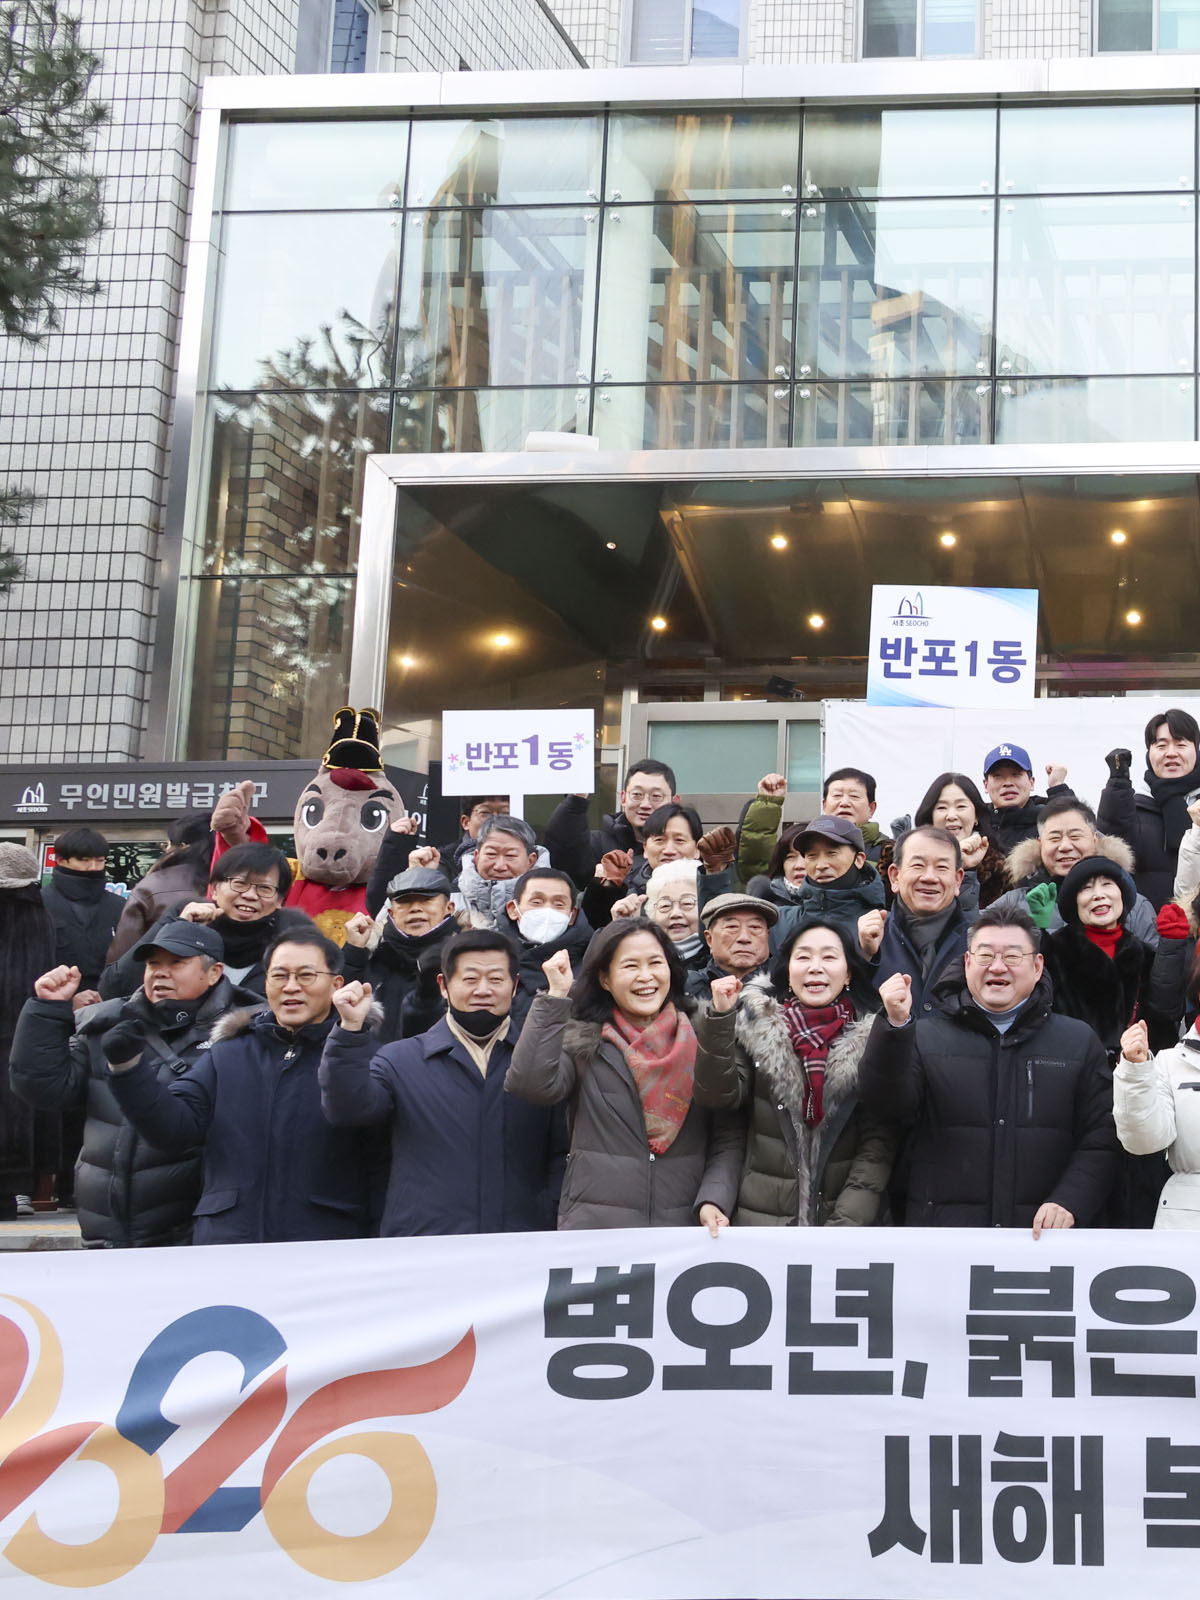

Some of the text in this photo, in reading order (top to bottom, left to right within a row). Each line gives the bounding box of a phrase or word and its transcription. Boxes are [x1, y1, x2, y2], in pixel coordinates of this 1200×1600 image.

[879, 636, 1027, 684] 반포1동
[905, 619, 929, 628] SEOCHO
[543, 1261, 929, 1401] 병오년,
[965, 1264, 1198, 1399] 붉은
[867, 1430, 1105, 1567] 새해
